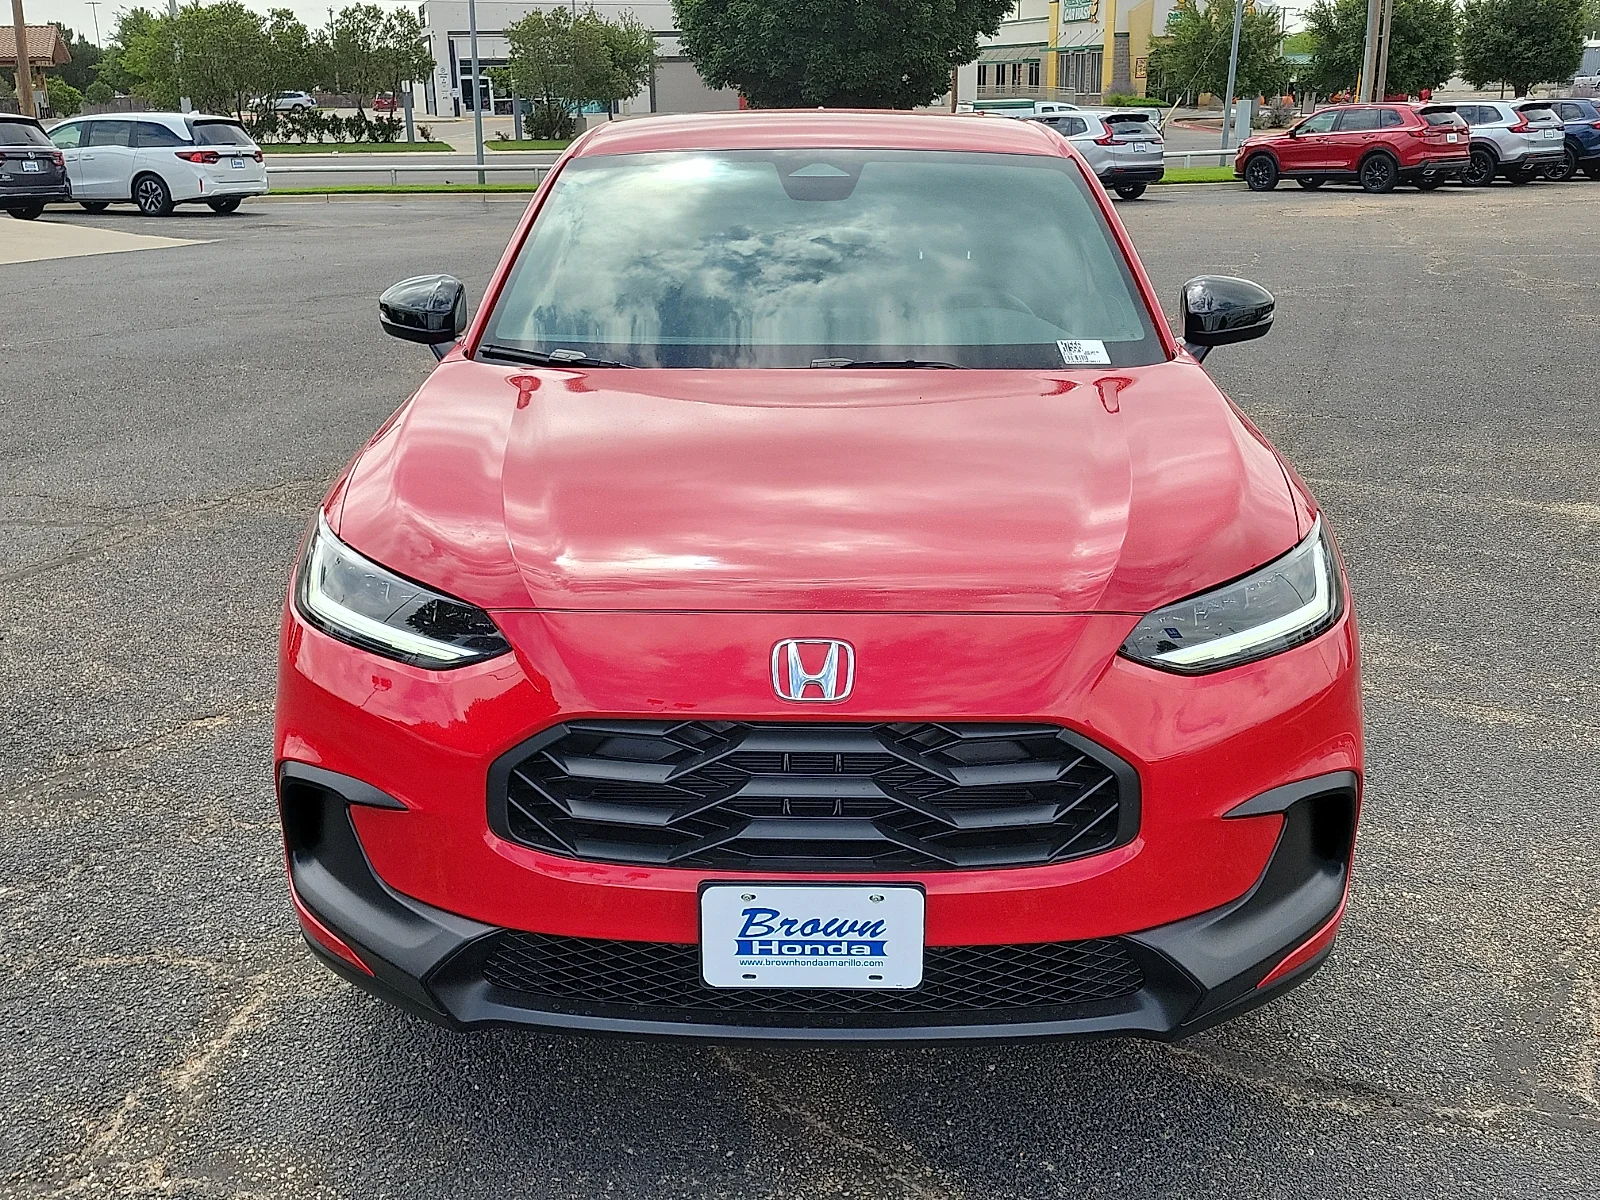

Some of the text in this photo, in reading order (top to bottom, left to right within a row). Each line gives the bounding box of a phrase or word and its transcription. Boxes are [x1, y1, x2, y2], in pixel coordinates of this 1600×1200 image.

[738, 908, 887, 938] Brown
[752, 940, 871, 955] Honda
[739, 958, 884, 968] www.brownhondaamarillo.com
